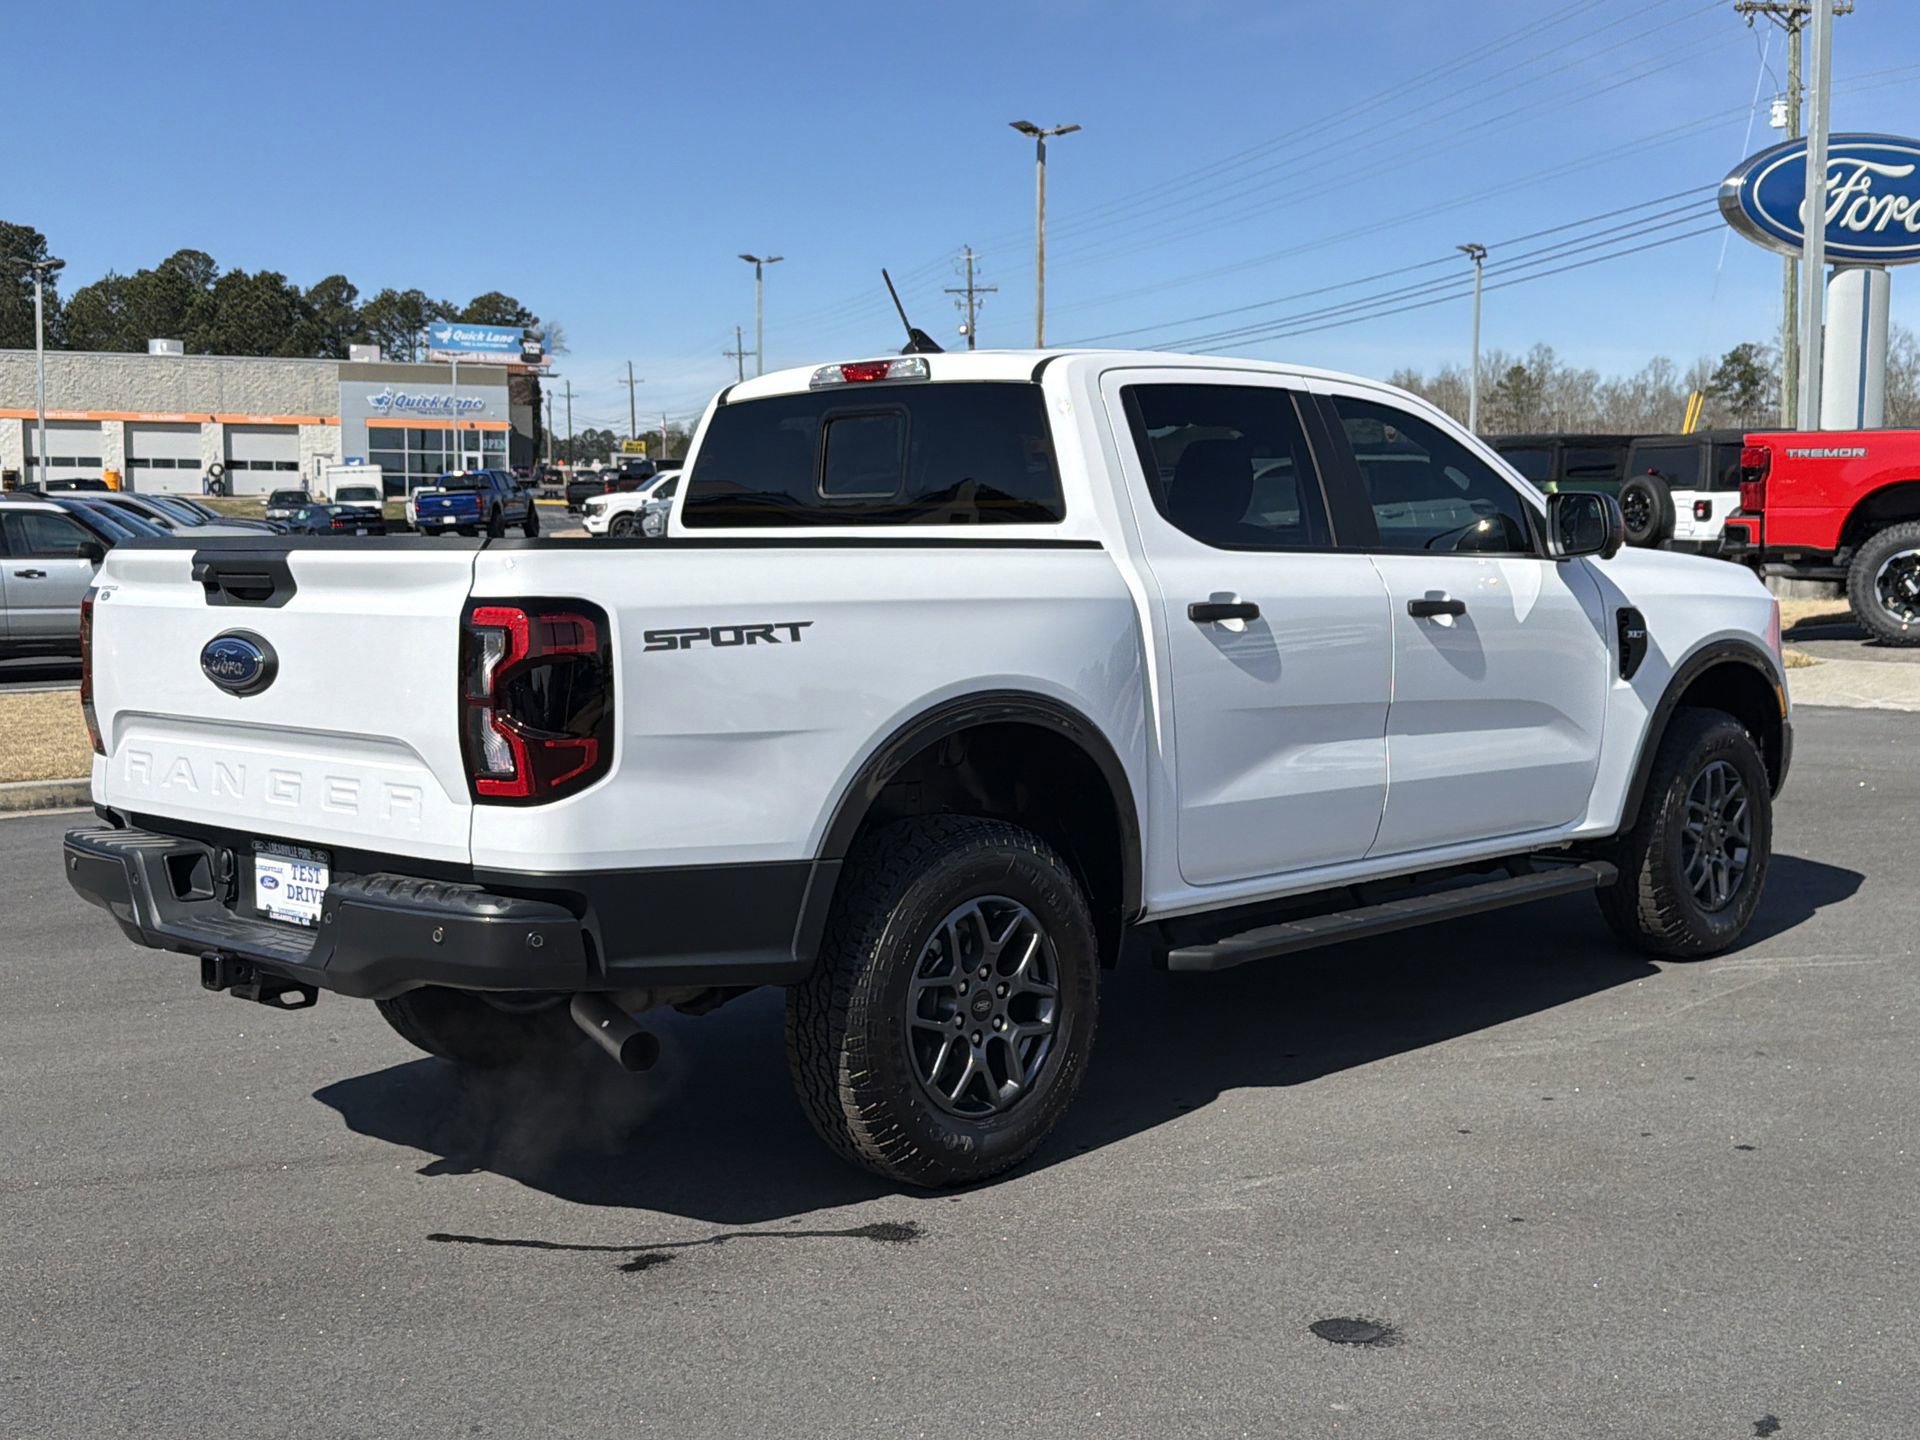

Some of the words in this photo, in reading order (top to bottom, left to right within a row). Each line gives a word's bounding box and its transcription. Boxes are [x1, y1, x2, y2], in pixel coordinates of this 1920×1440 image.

[453, 330, 485, 341] Quick
[486, 331, 515, 343] Lane
[395, 394, 438, 410] Quick
[1785, 447, 1867, 459] TREMOR
[643, 621, 814, 652] SPORT
[211, 648, 246, 676] Ford
[124, 750, 423, 825] RANGER
[291, 863, 321, 884] TEST
